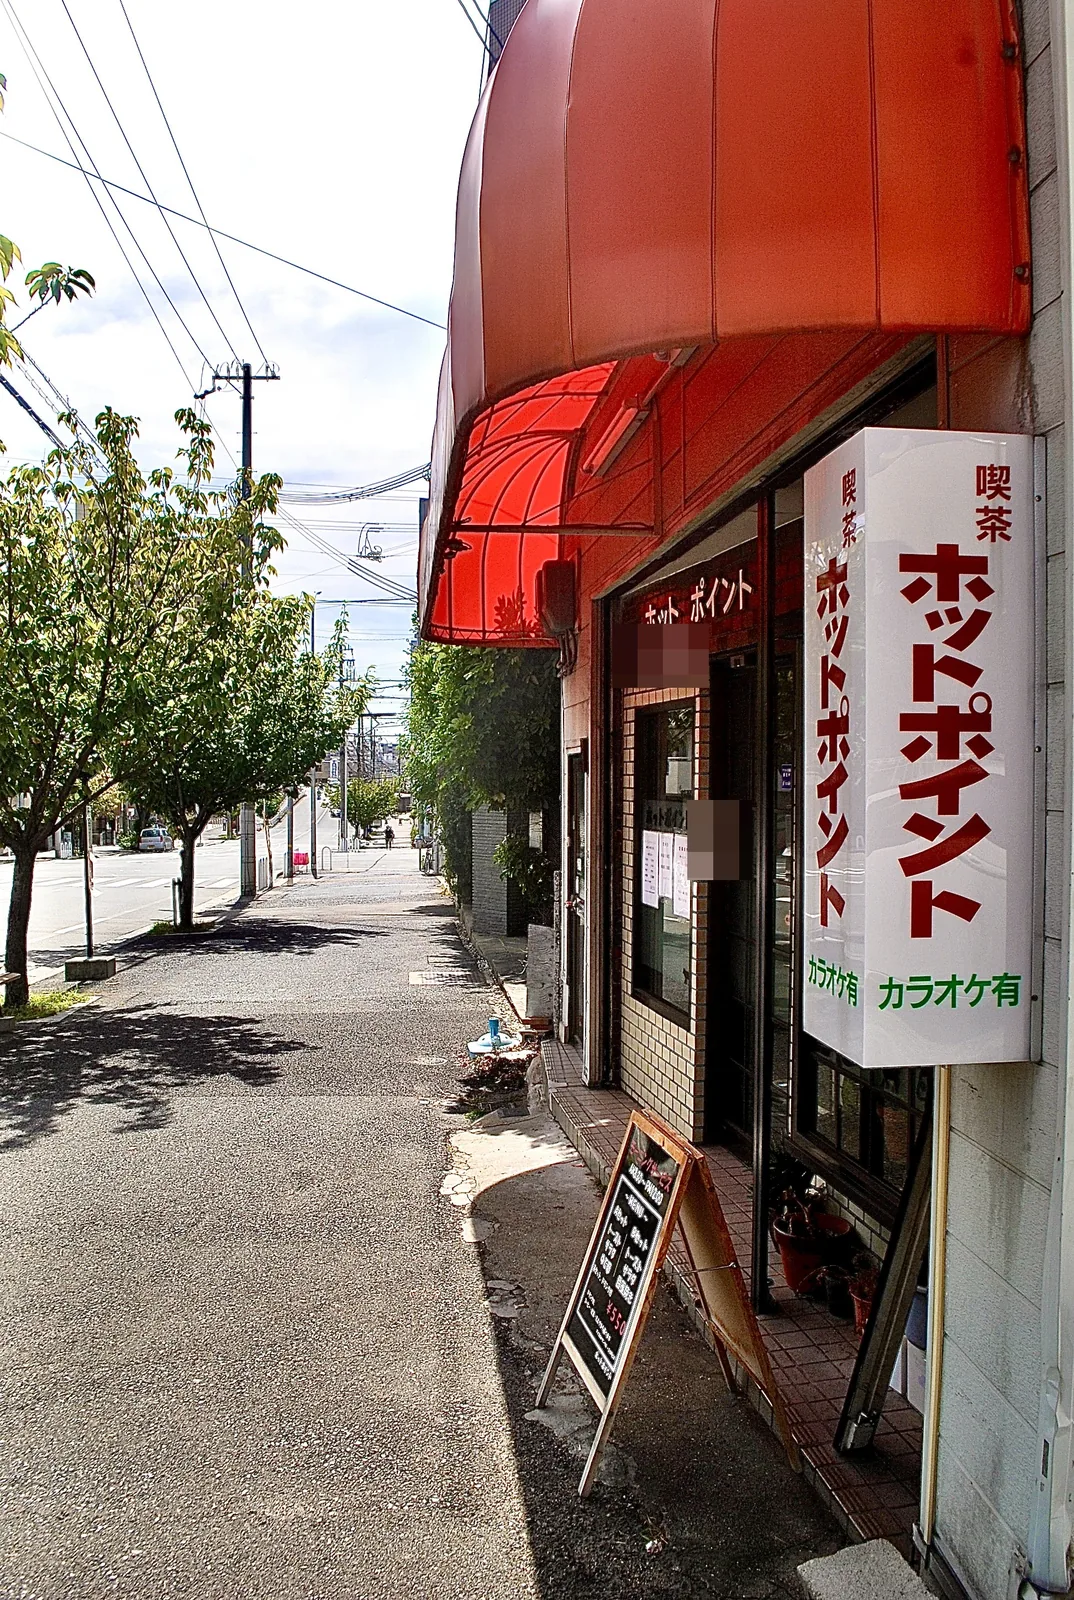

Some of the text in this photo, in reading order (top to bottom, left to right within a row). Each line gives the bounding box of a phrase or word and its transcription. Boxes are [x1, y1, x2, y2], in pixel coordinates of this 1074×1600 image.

[841, 468, 858, 548] 喫茶
[975, 463, 1012, 543] 喫茶
[690, 569, 752, 622] ポイント
[816, 557, 850, 927] ホットポイント
[898, 541, 994, 938] ホットポイント
[809, 954, 858, 1007] カラオケ有
[878, 973, 1021, 1010] カラオケ有
[624, 1246, 643, 1273] トースト
[606, 1300, 626, 1336] ¥550
